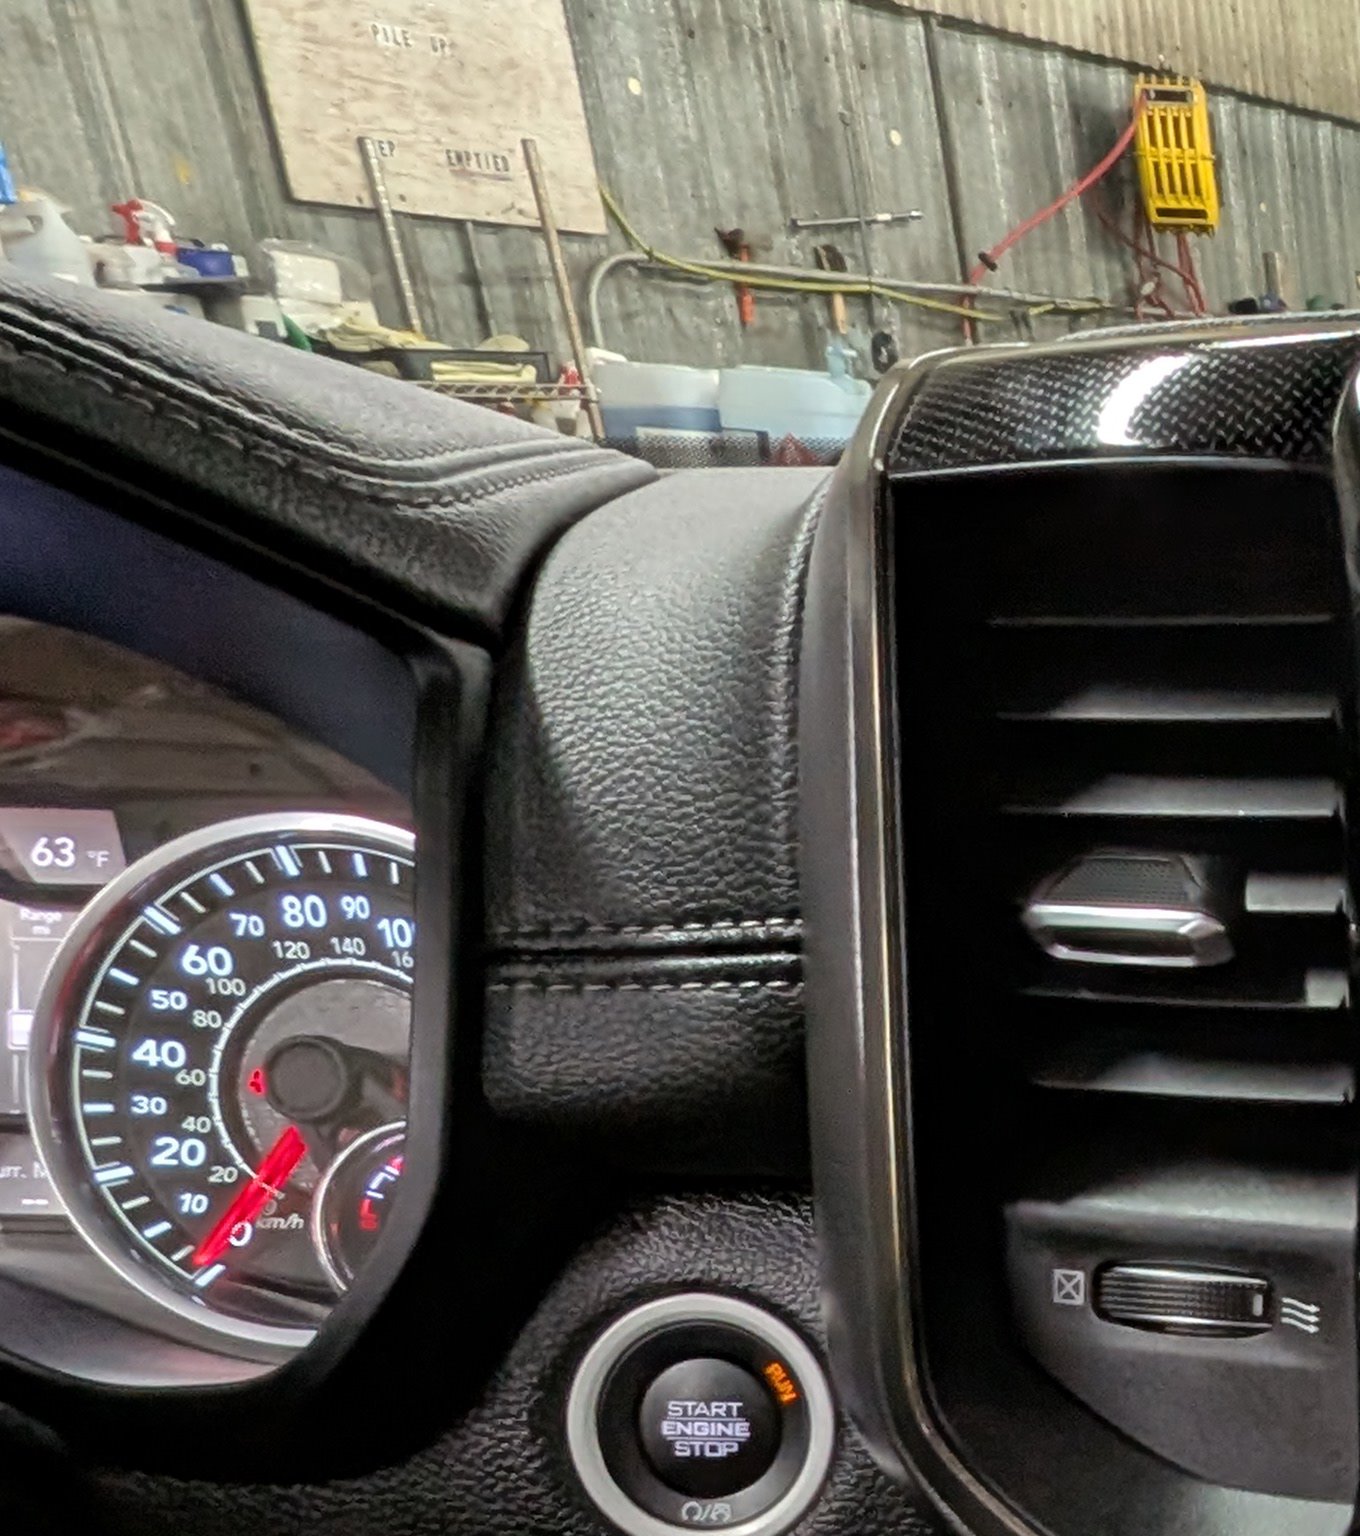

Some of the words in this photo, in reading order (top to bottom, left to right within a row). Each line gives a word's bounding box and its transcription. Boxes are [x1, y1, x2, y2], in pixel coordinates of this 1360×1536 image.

[445, 149, 511, 172] EMPTIED
[31, 836, 76, 868] 63
[86, 850, 110, 868] °F
[281, 894, 327, 928] 80
[340, 895, 371, 920] 90
[229, 912, 265, 937] 70
[376, 917, 415, 949] 10
[272, 939, 311, 961] 120
[330, 937, 366, 957] 140
[180, 944, 233, 977] 60
[391, 951, 415, 968] 16
[205, 977, 247, 997] 100
[150, 990, 188, 1010] 50
[192, 1010, 223, 1029] 80
[132, 1039, 187, 1068] 40
[175, 1069, 206, 1086] 60
[131, 1096, 167, 1115] 30
[181, 1116, 212, 1133] 40
[151, 1136, 207, 1167] 20
[208, 1166, 239, 1184] 20
[179, 1193, 209, 1215] 10
[256, 1215, 305, 1230] km/h
[228, 1221, 253, 1247] 0
[764, 1362, 798, 1404] RUN
[667, 1400, 744, 1417] START
[661, 1420, 751, 1437] ENGINE
[673, 1441, 739, 1457] STOP
